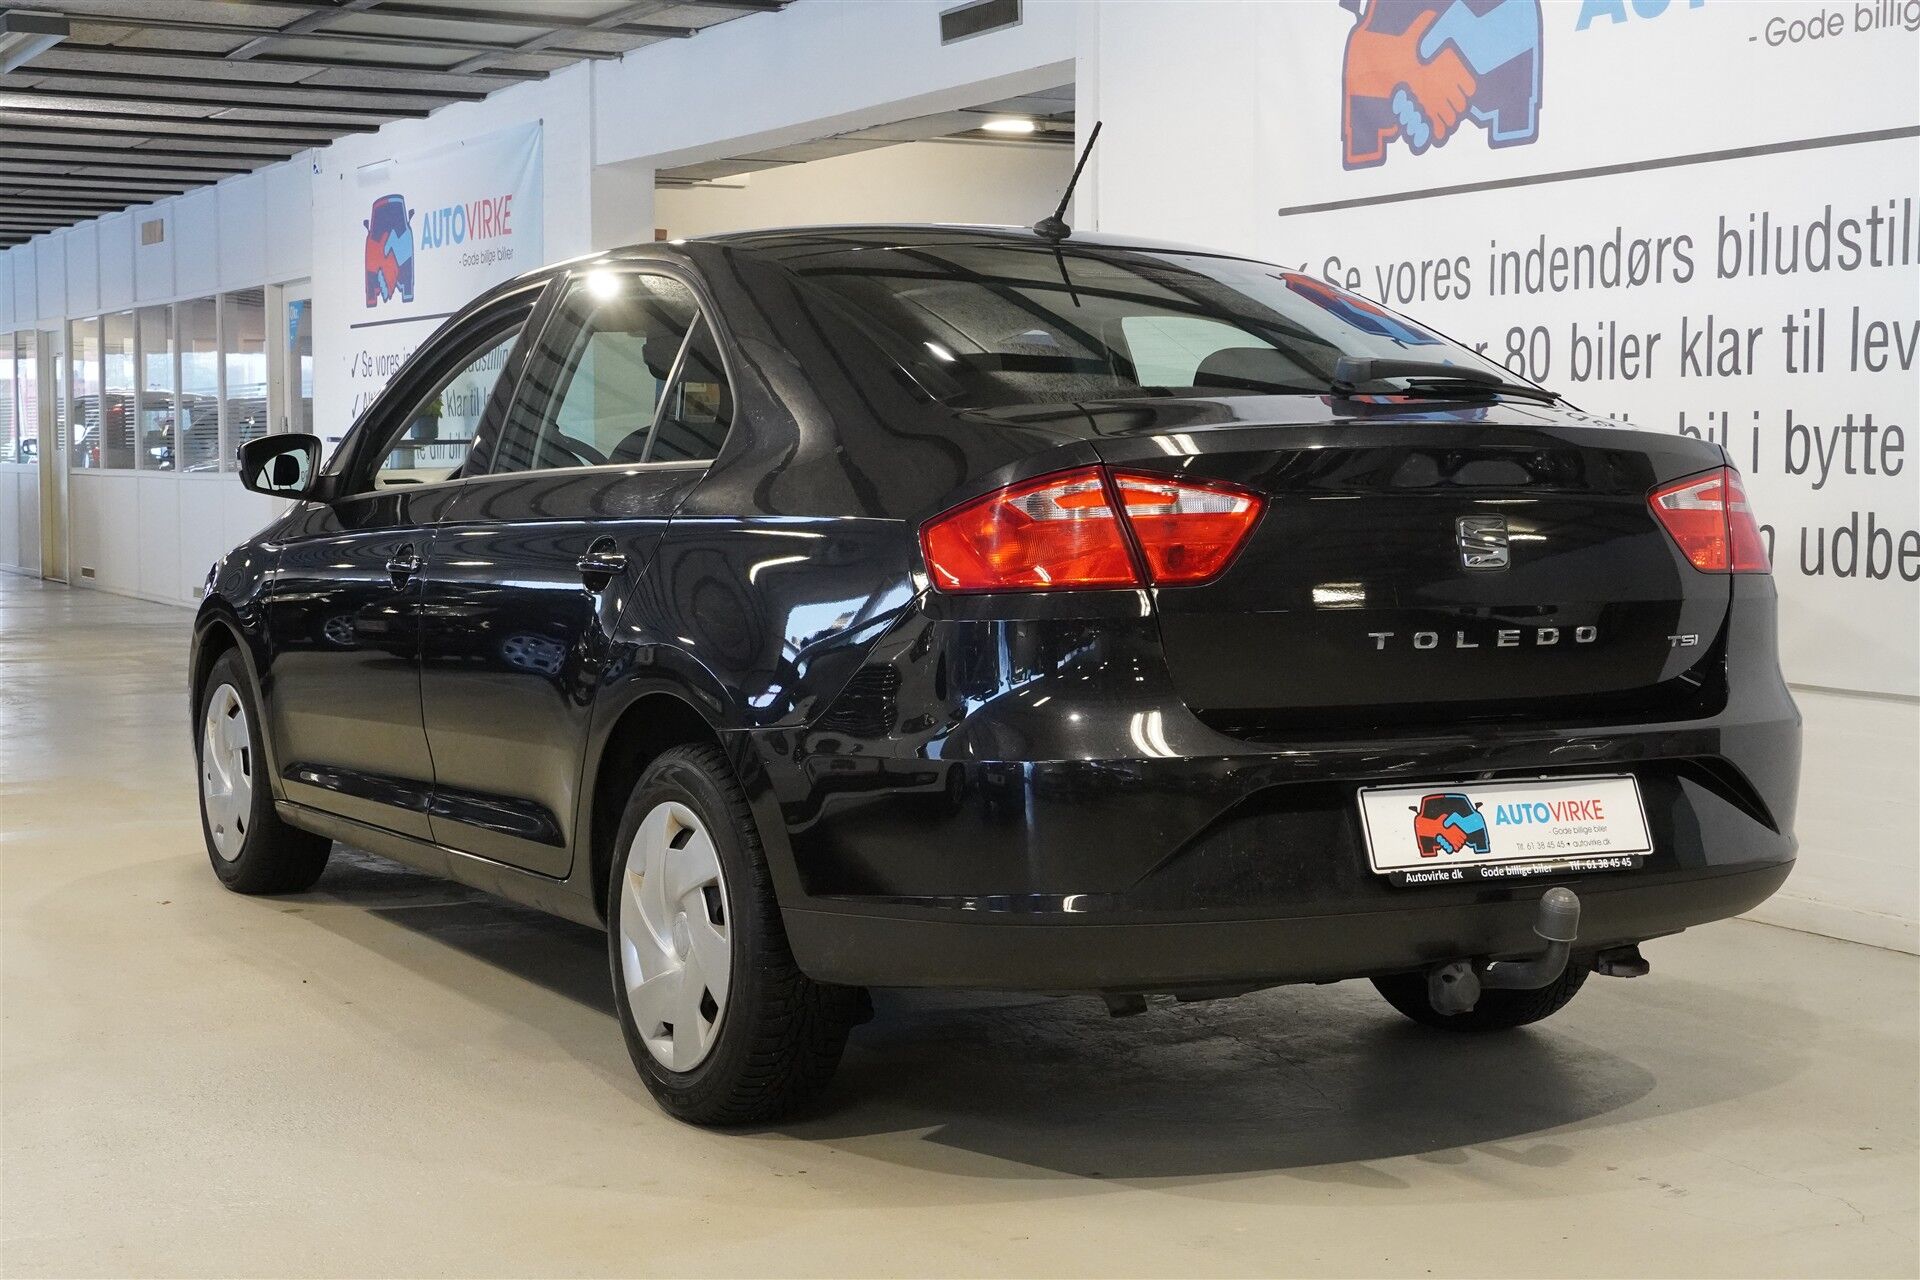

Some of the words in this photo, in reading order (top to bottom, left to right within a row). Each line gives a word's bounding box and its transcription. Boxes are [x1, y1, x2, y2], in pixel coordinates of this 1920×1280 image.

[1765, 9, 1844, 47] Gode
[421, 194, 513, 251] AUTOVIRKE
[462, 252, 479, 267] Gode
[480, 249, 496, 266] billige
[497, 246, 514, 261] biler
[1323, 255, 1361, 295] Se
[1376, 255, 1471, 305] vores
[1489, 226, 1695, 296] indendørs
[1504, 326, 1550, 384] 80
[1571, 320, 1661, 382] biler
[1680, 314, 1764, 378] klar
[1782, 307, 1825, 374] til
[1850, 306, 1920, 372] lev
[361, 350, 373, 378] Se
[375, 354, 400, 377] vores
[446, 388, 467, 417] klar
[470, 387, 480, 417] til
[1752, 411, 1760, 474] i
[1784, 409, 1905, 491] bytte
[1800, 511, 1920, 582] udbe
[1368, 625, 1597, 650] TOLEDO
[1667, 634, 1699, 648] TSI
[1496, 800, 1605, 826] AUTOVIRKE
[1553, 826, 1572, 836] Gode
[1573, 825, 1593, 836] billige
[1593, 824, 1608, 833] biler
[1527, 841, 1535, 850] 61
[1537, 841, 1546, 850] 38
[1547, 841, 1556, 849] 45
[1556, 840, 1566, 849] 45
[1405, 870, 1450, 883] Autovirke
[1451, 868, 1464, 880] dk
[1480, 866, 1505, 877] Gode
[1506, 863, 1532, 877] billige
[1533, 862, 1553, 874] biler
[1587, 859, 1598, 869] 61
[1598, 858, 1609, 869] 38
[1609, 857, 1620, 868] 45
[1621, 857, 1632, 867] 45
